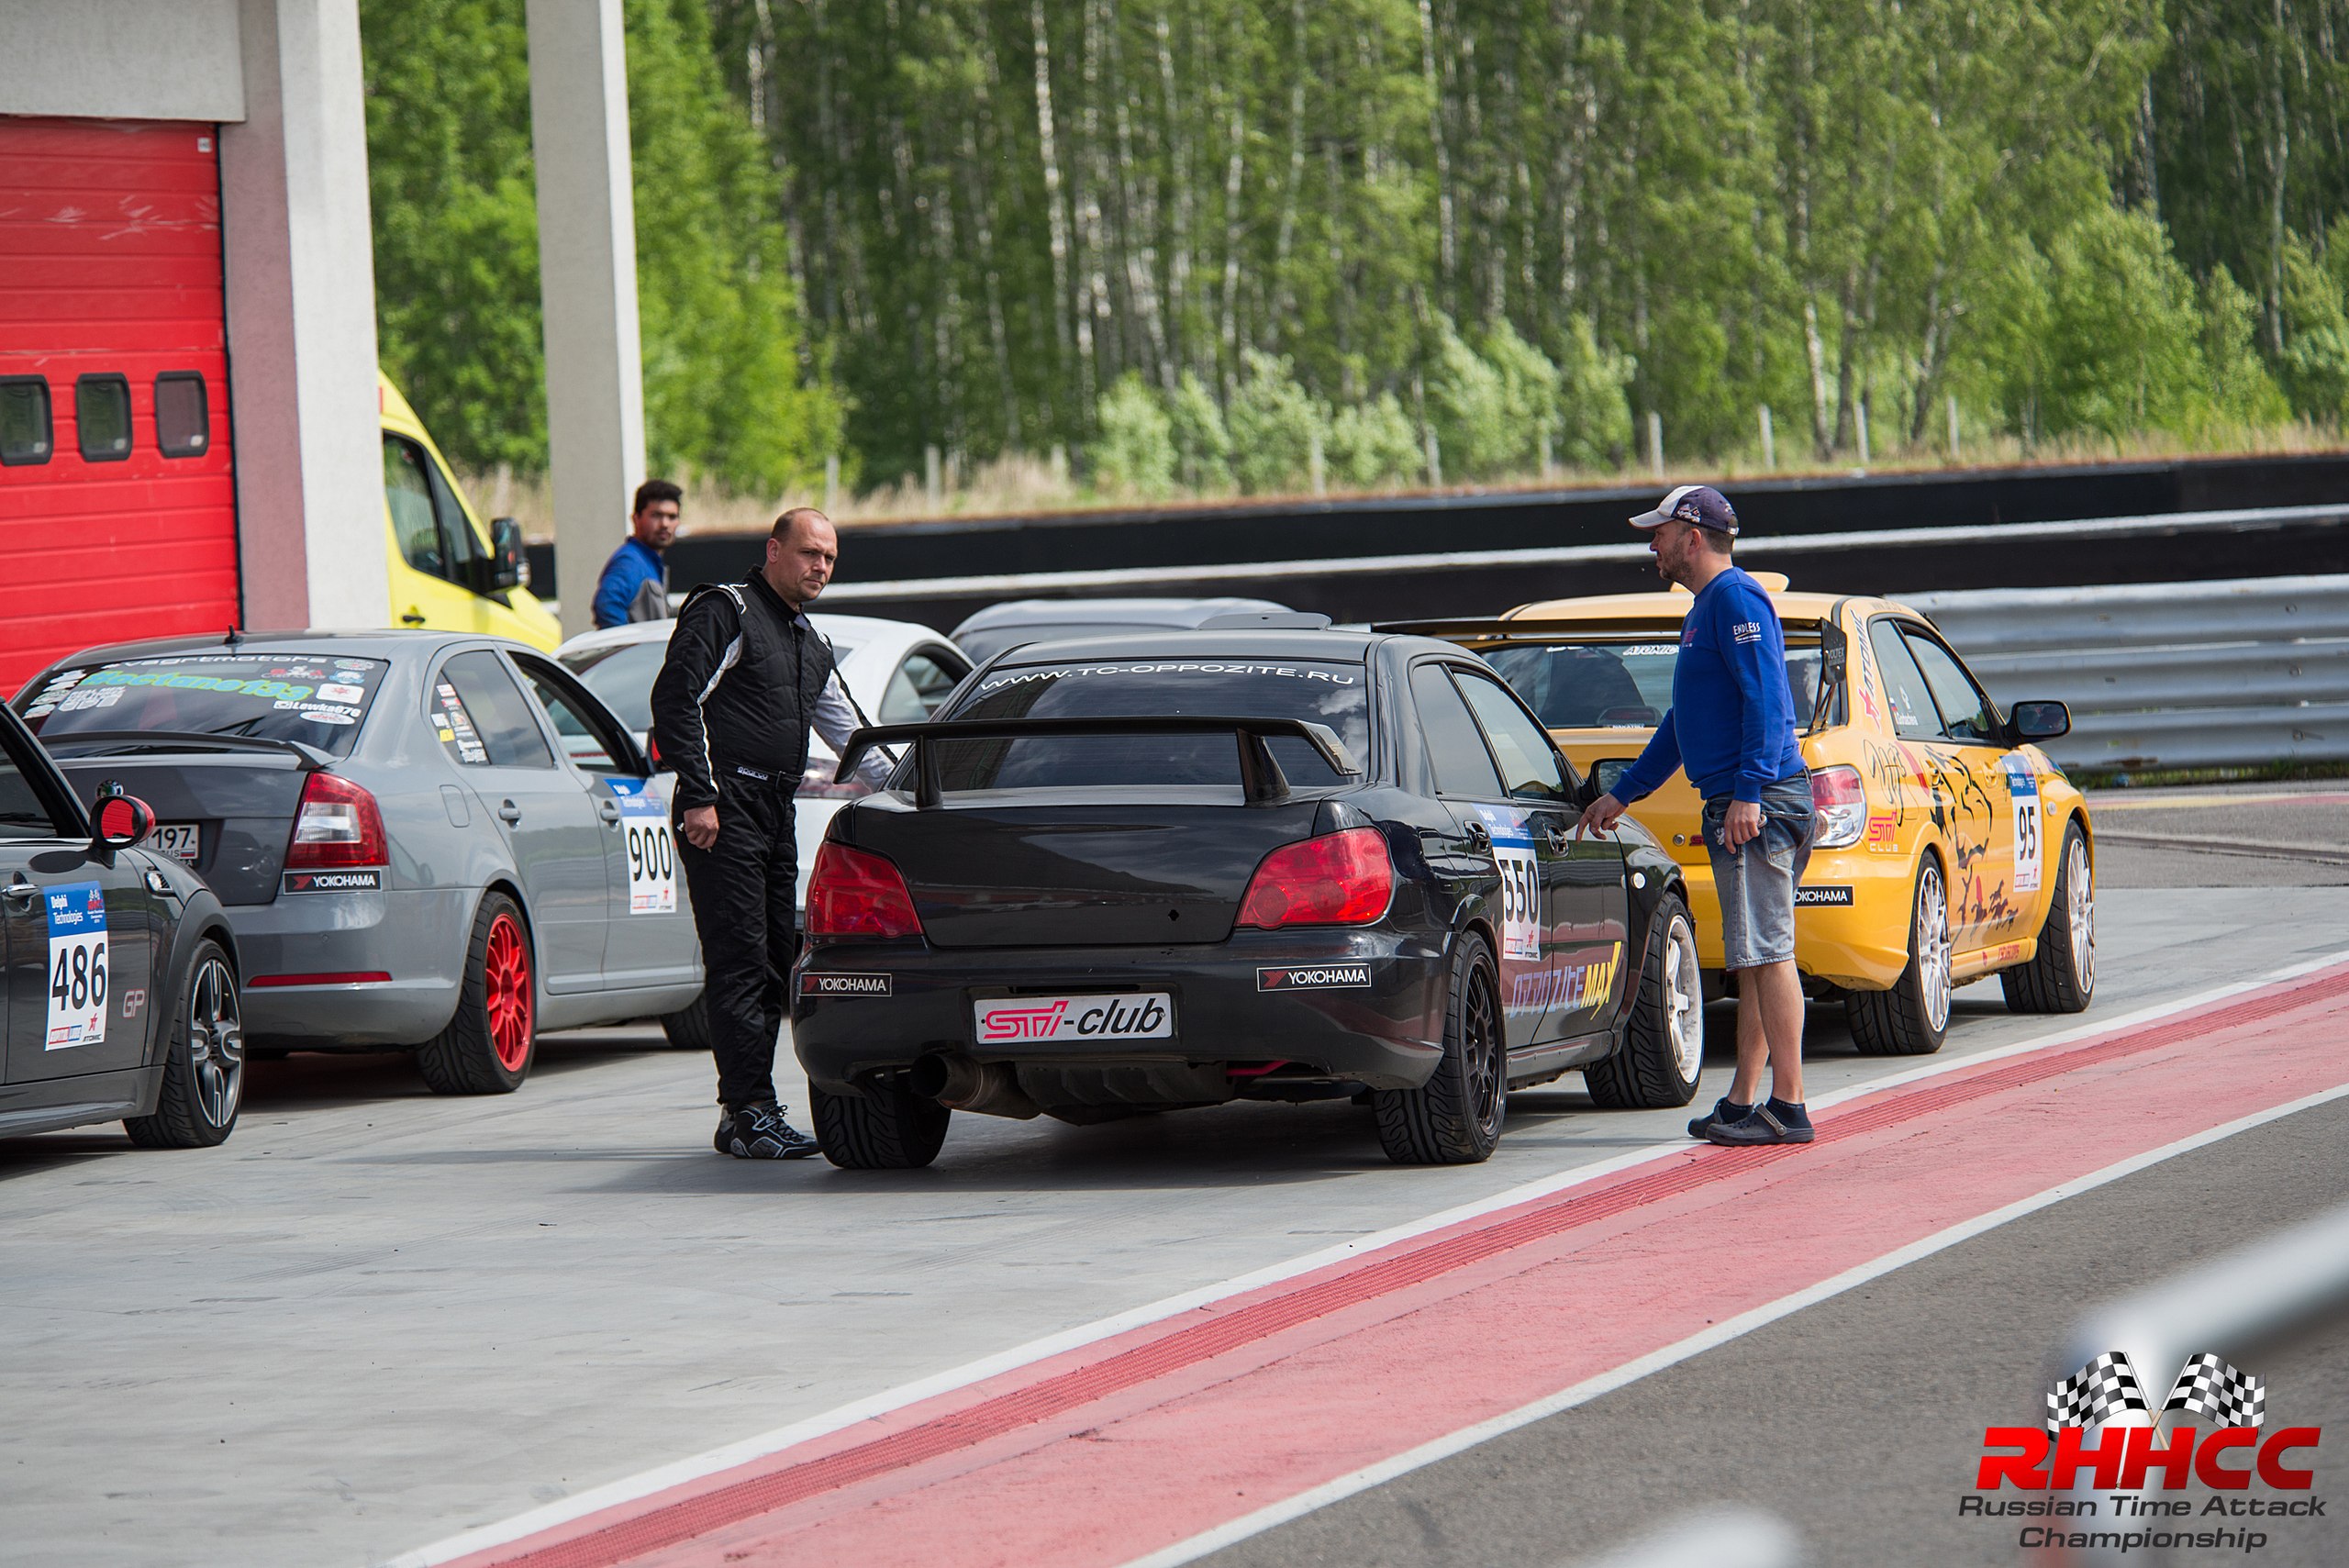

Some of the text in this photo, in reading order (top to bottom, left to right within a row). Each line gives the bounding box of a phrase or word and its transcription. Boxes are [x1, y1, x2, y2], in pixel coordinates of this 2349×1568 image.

[1733, 622, 1761, 635] ENDLESS
[1622, 644, 1679, 655] ATOMIC
[737, 766, 769, 781] sparco
[150, 827, 190, 850] 197
[2019, 806, 2036, 861] 95
[629, 827, 672, 882] 900
[1869, 843, 1898, 852] CLUB
[313, 874, 375, 888] YOKOHAMA
[1497, 859, 1539, 924] 550
[1794, 890, 1849, 903] OKOHAMA
[50, 894, 69, 909] Delphi
[52, 909, 83, 926] Technologies
[51, 942, 106, 1011] 486
[1287, 969, 1367, 985] YOKOHAMA
[818, 977, 886, 992] YOKOHAMA
[122, 989, 146, 1018] GP
